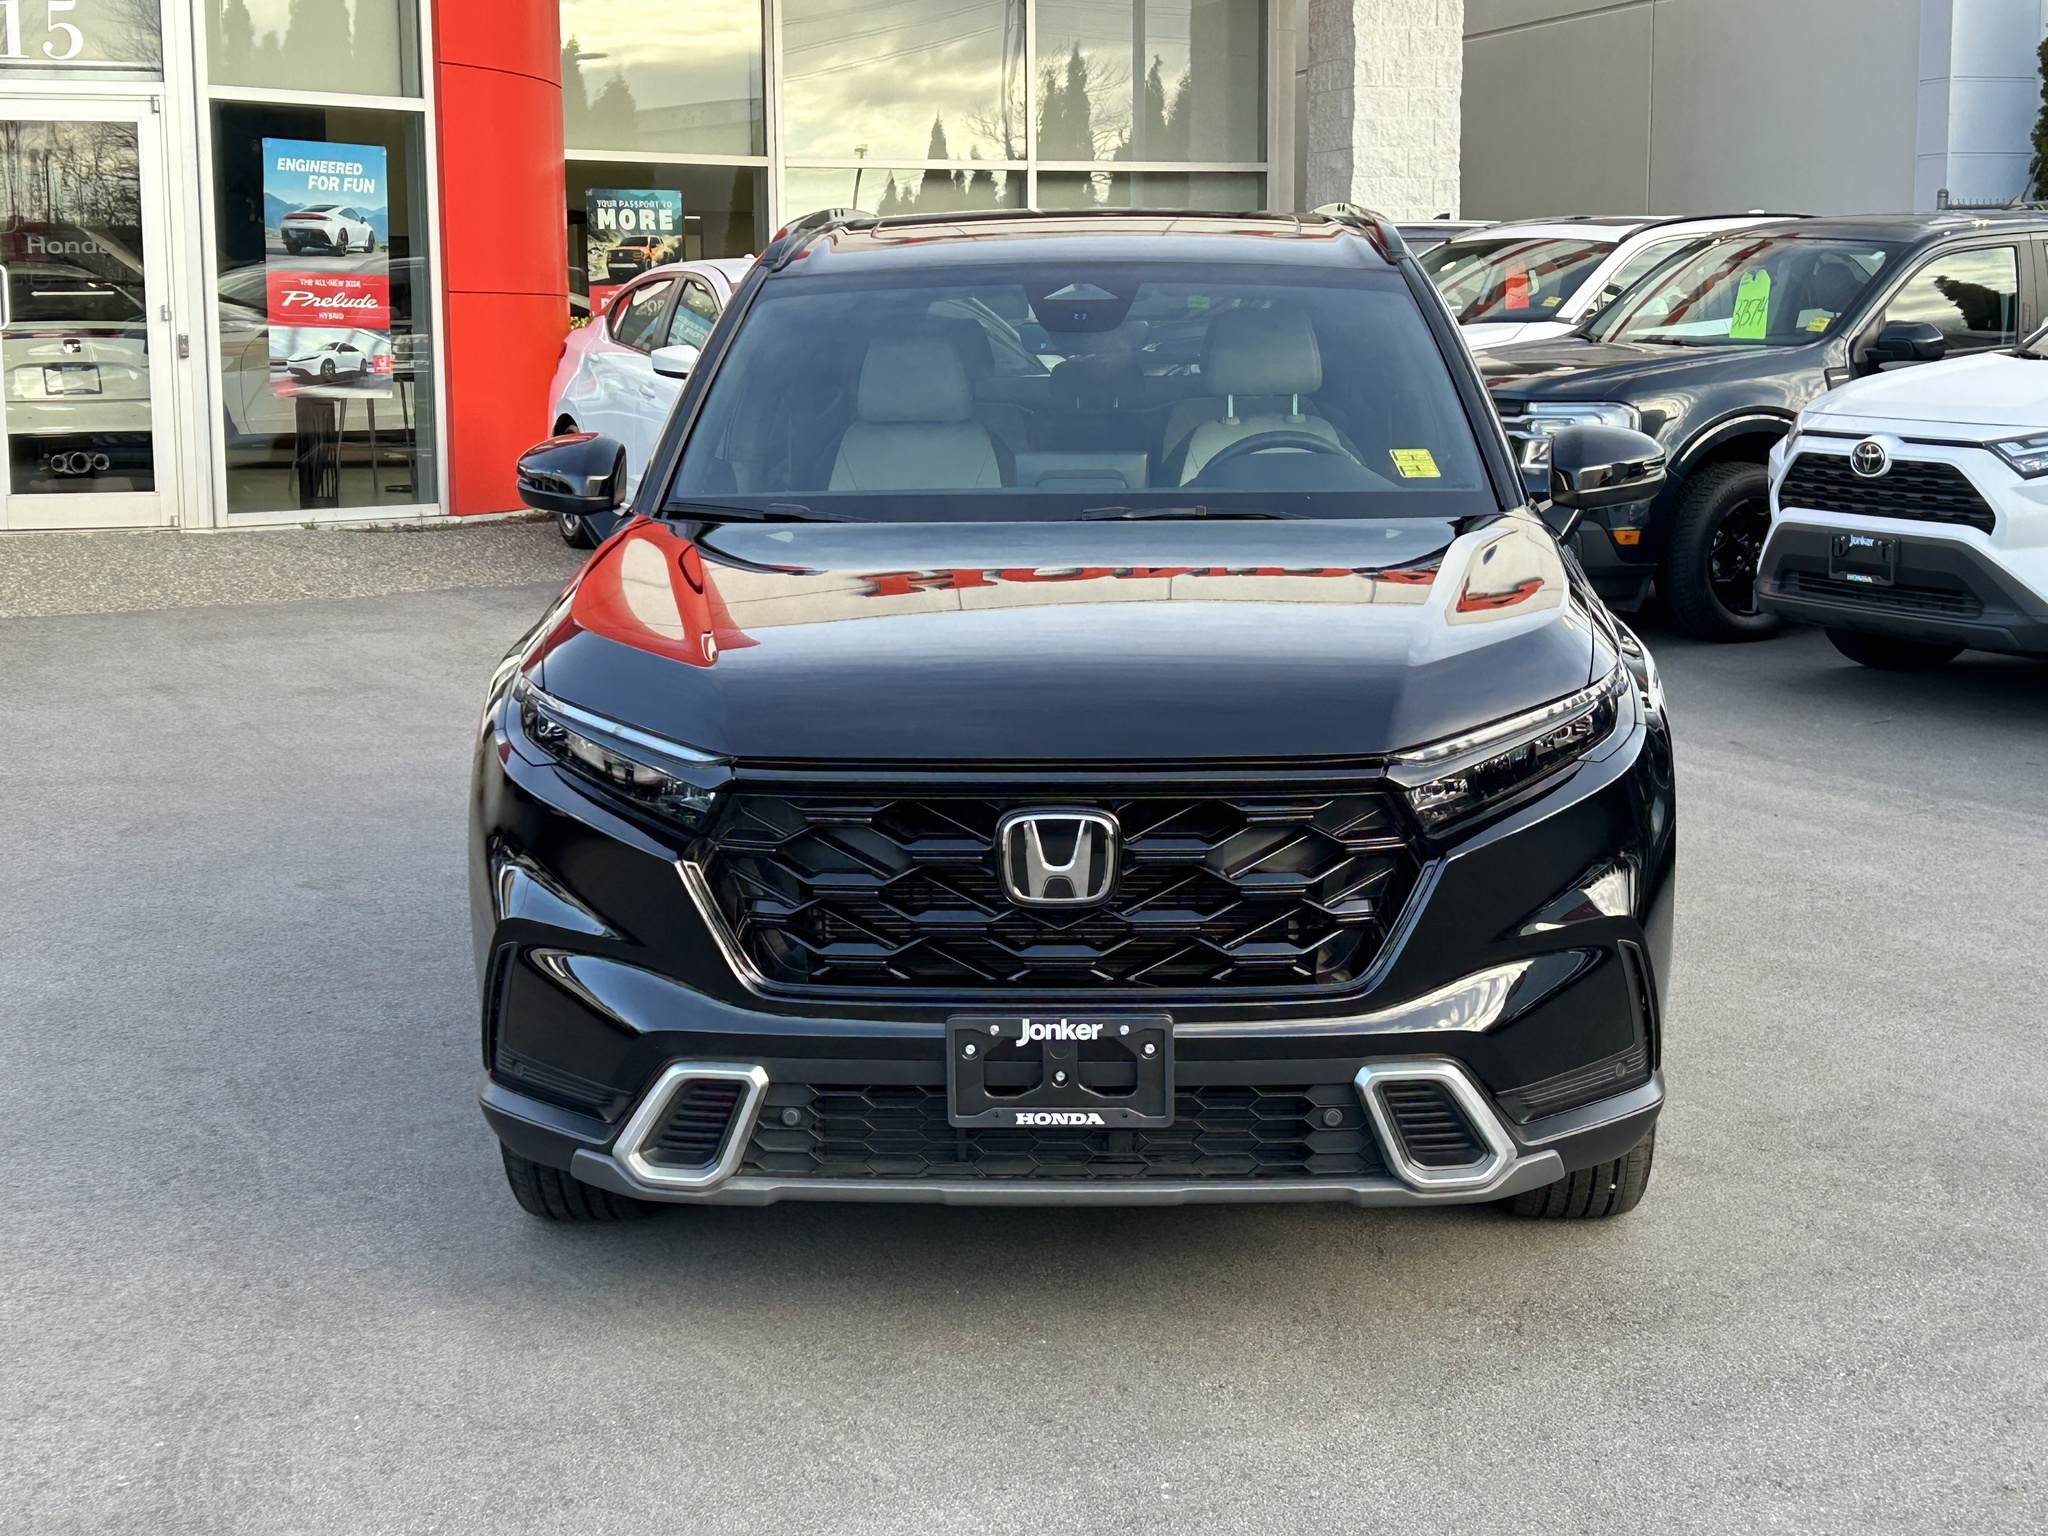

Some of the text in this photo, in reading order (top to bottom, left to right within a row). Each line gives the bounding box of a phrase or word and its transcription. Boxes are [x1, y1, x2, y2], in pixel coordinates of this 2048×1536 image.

[277, 157, 363, 176] ENGINEERED
[308, 175, 376, 194] FOR FUN
[597, 199, 617, 208] YOUR
[597, 208, 673, 230] MORE
[281, 290, 379, 309] Prelude
[1016, 1018, 1104, 1047] Jonker
[1016, 1112, 1105, 1125] HONDA
